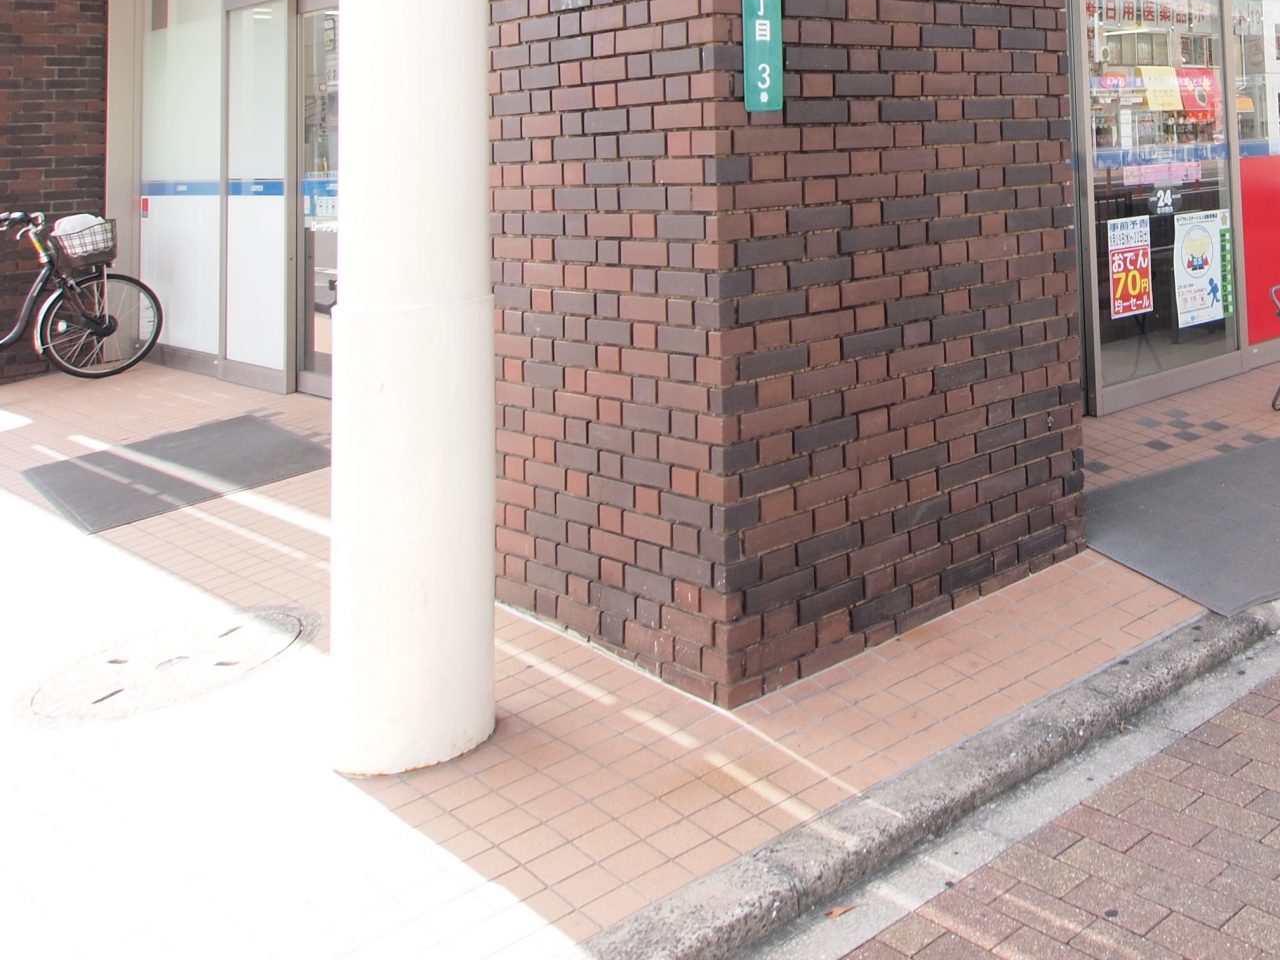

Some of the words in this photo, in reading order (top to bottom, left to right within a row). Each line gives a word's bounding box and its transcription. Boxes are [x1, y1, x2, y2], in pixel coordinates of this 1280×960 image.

[1156, 189, 1172, 207] 24
[1112, 249, 1149, 273] おでん
[1113, 269, 1149, 300] 70円
